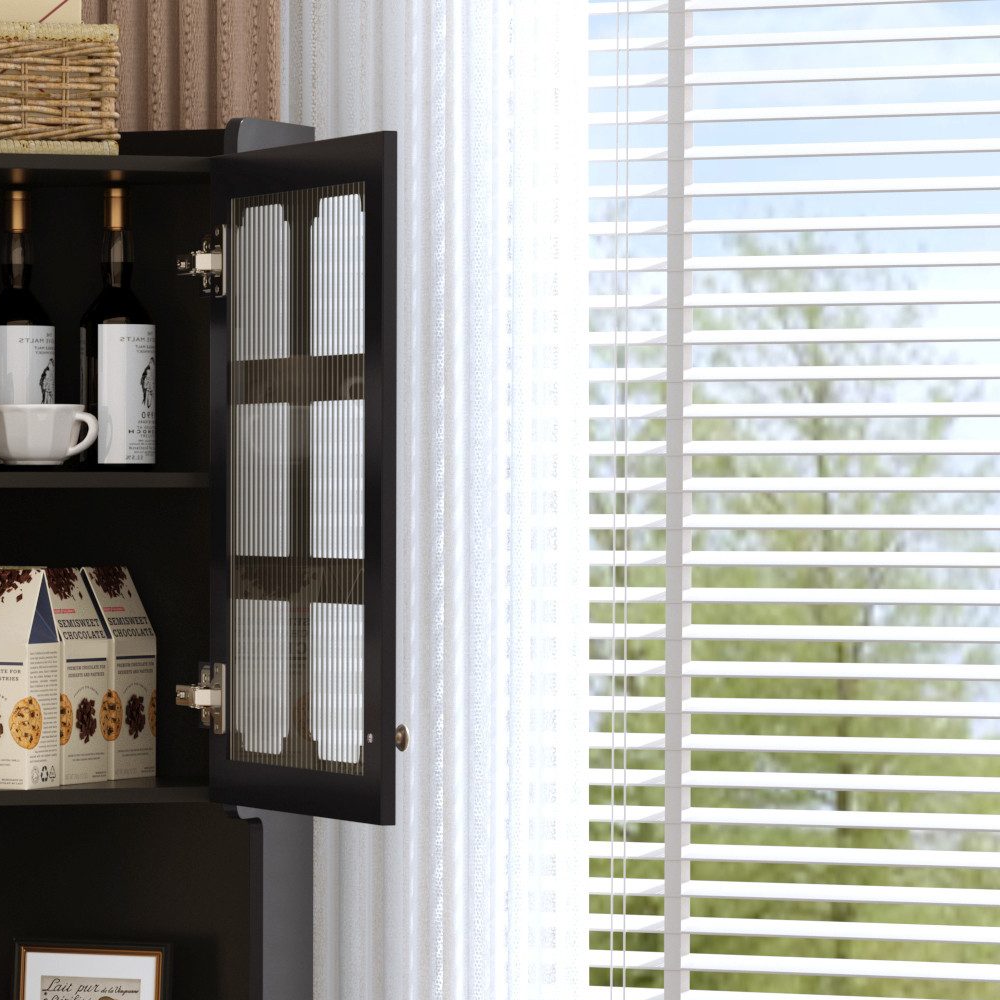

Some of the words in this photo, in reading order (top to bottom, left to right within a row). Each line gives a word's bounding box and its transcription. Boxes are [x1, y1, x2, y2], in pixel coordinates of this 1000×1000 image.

[57, 618, 100, 628] SEMISWEET
[107, 616, 148, 626] SEMISWEET
[62, 630, 106, 640] CHOCOLATE
[112, 627, 154, 638] CHOCOLATE
[41, 977, 73, 992] Lait
[75, 983, 100, 995] pur
